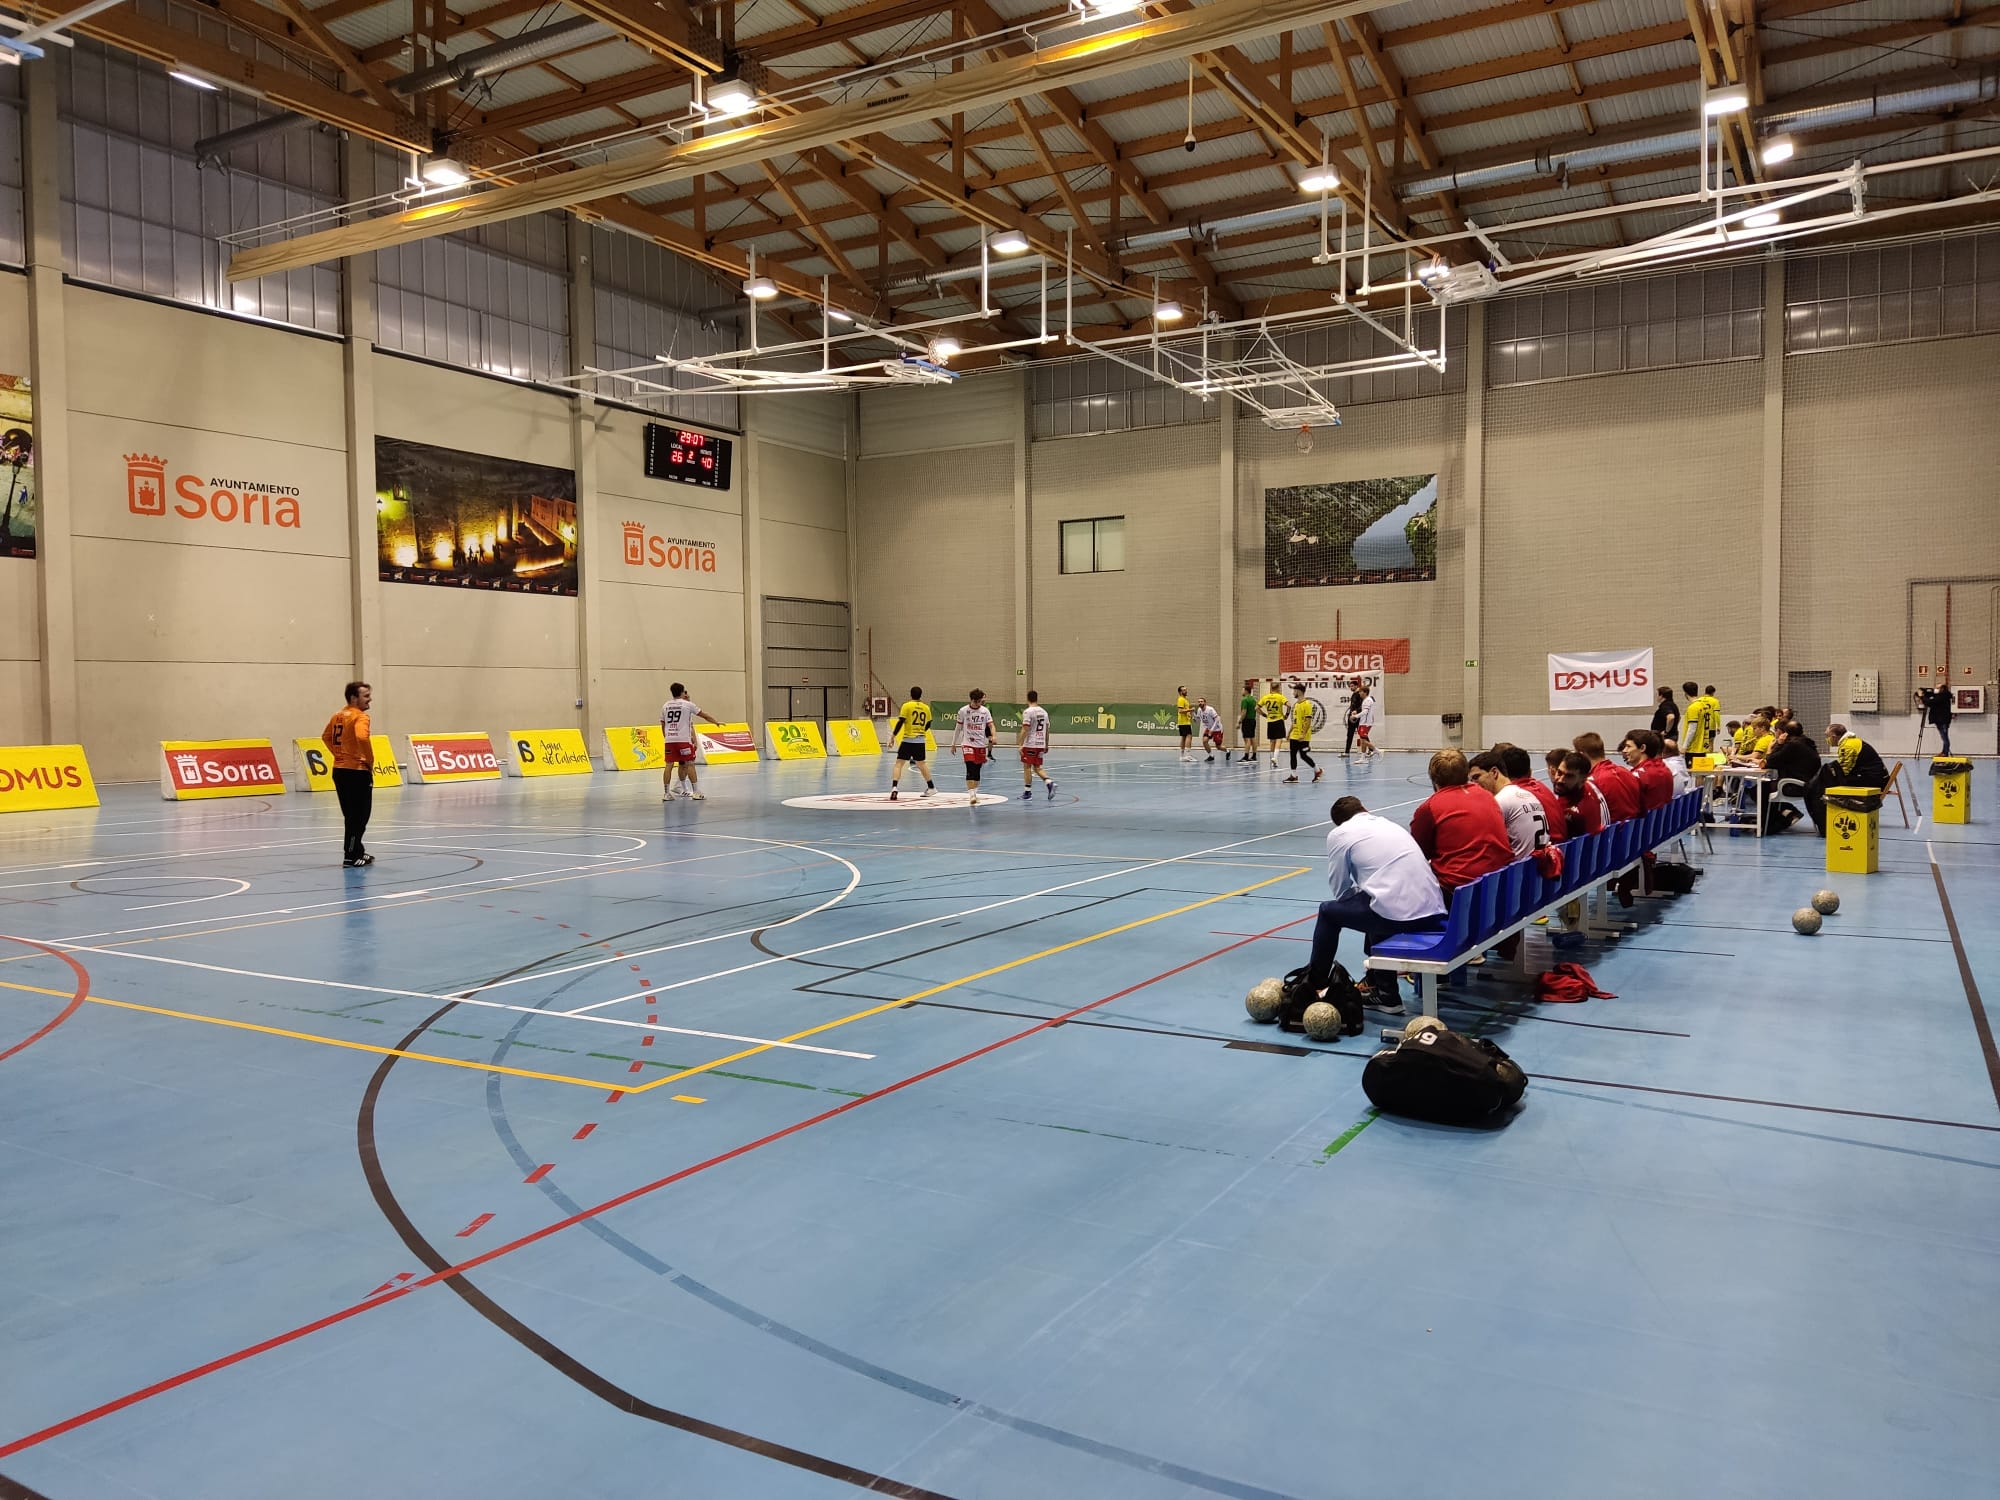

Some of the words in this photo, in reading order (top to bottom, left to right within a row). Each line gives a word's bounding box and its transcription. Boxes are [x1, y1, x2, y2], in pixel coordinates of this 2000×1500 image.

[680, 431, 704, 446] 29:07
[671, 450, 683, 463] 26
[688, 450, 694, 460] 2
[701, 457, 713, 469] 40
[209, 477, 300, 496] AYUNTAMIENTO
[174, 474, 301, 528] Soria
[667, 537, 716, 549] AYUNTAMIENTO
[648, 535, 716, 572] Soria
[1324, 650, 1384, 670] Soria
[1554, 667, 1649, 691] DOMUS
[1265, 700, 1279, 712] 24
[667, 710, 682, 724] 99
[912, 710, 927, 726] 29
[941, 712, 959, 721] JOVE
[1000, 718, 1018, 729] Caja
[1071, 715, 1095, 725] JOVEN
[1097, 706, 1116, 730] in
[1136, 720, 1156, 731] Caja
[333, 724, 344, 746] 12
[778, 724, 801, 742] 20
[540, 739, 562, 755] Agua
[439, 750, 498, 770] Soria
[555, 752, 589, 765] Calidad
[0, 765, 82, 792] OMUS
[203, 760, 275, 783] Soria
